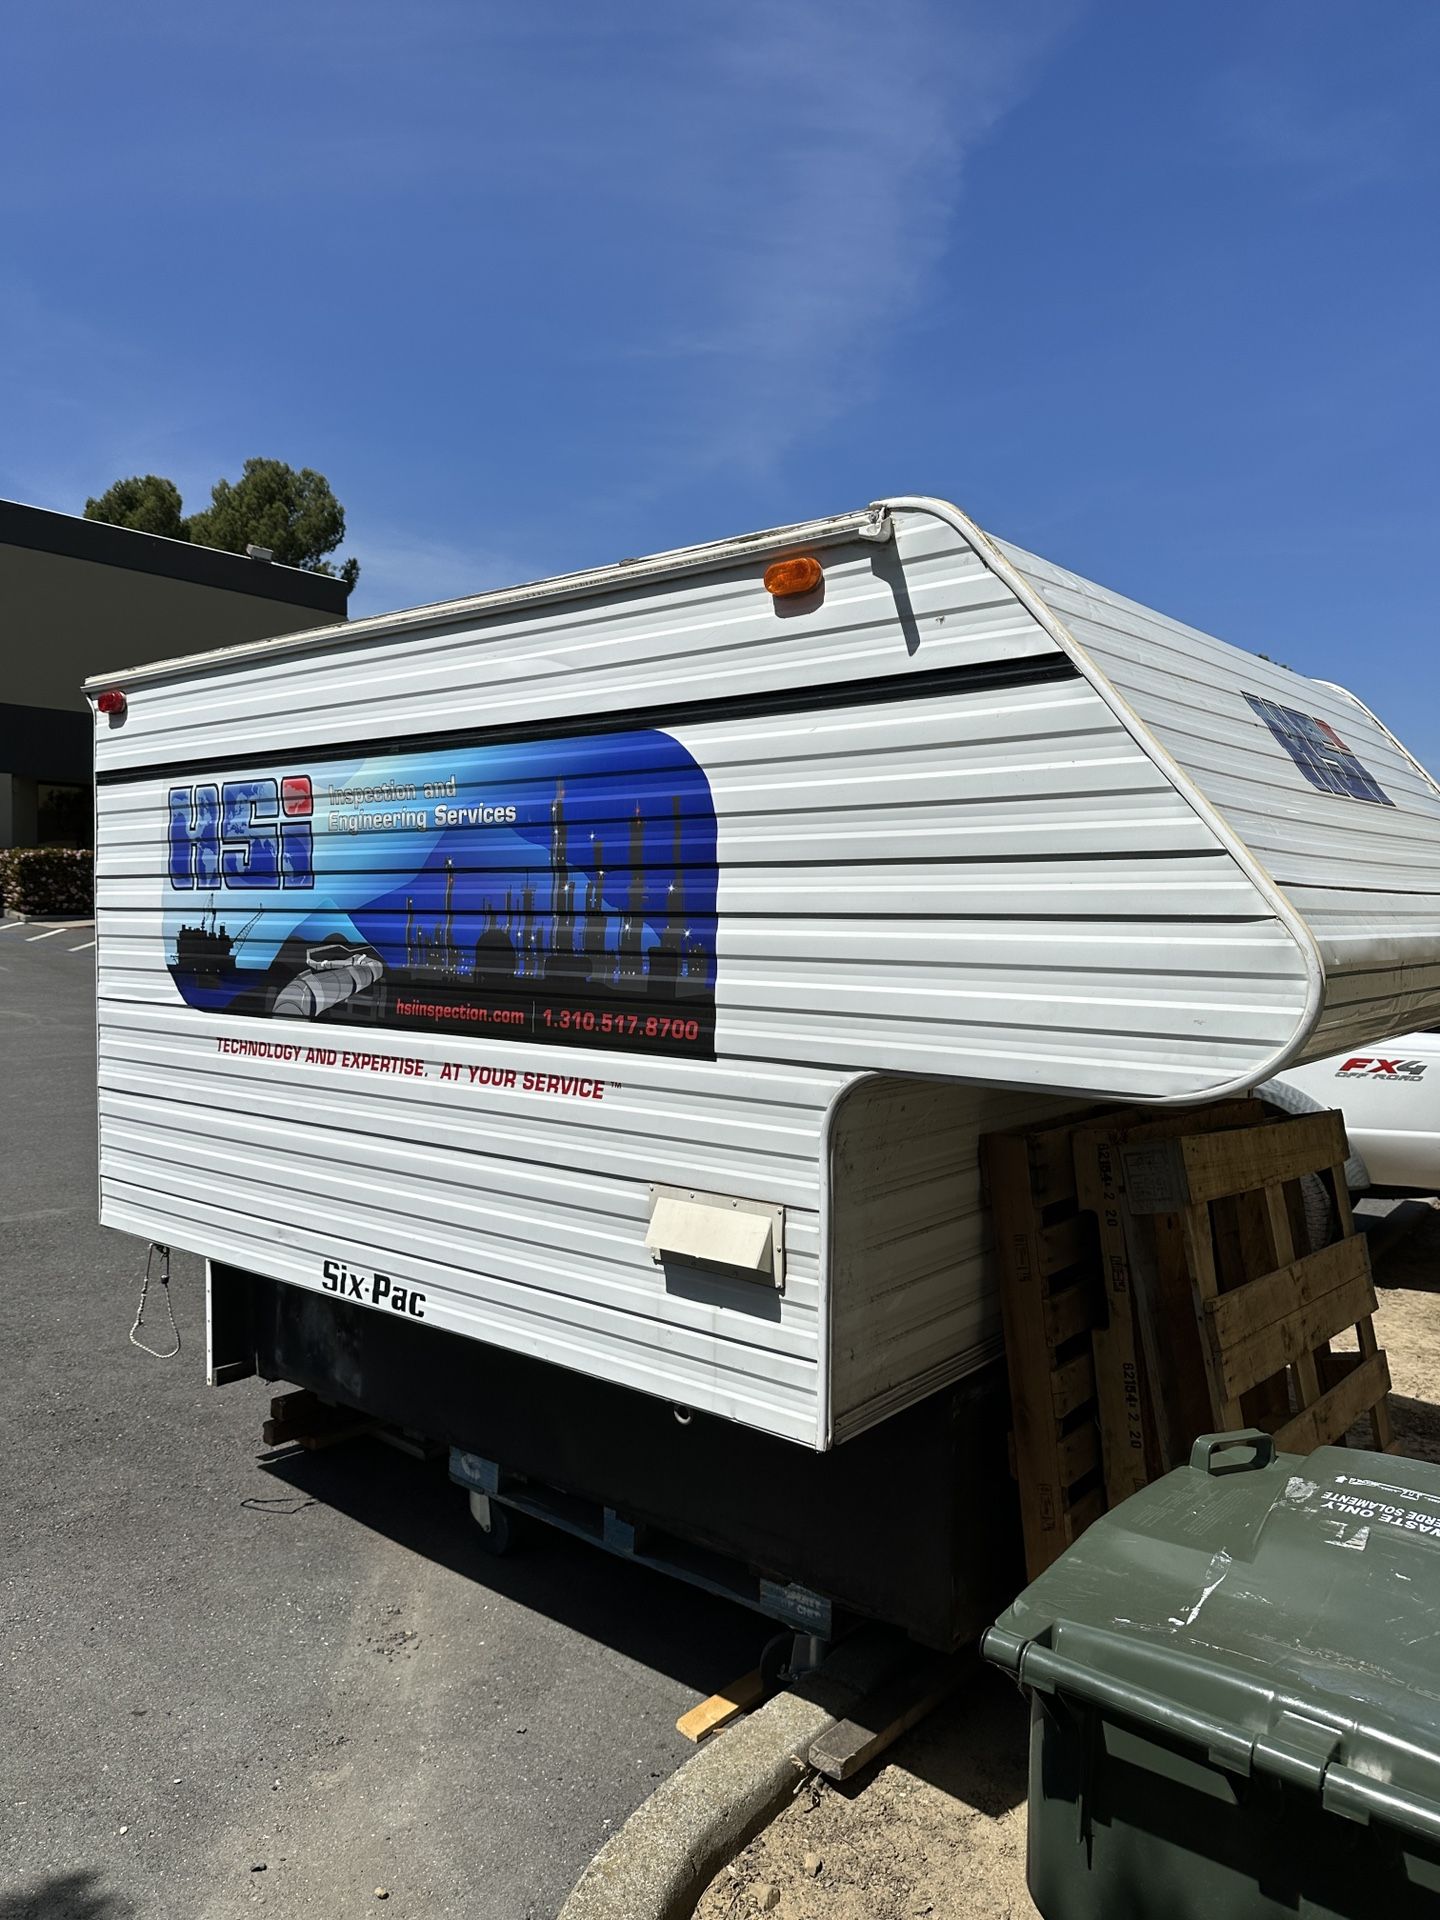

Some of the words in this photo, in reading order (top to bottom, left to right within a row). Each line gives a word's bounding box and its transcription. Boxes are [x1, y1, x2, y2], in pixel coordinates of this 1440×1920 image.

[328, 779, 417, 808] Inspection
[423, 774, 457, 798] and
[327, 806, 427, 835] Engineering
[434, 802, 516, 826] Services
[396, 998, 524, 1025] hsiinspection.com
[543, 1008, 699, 1040] 1.310.517.8700
[216, 1037, 302, 1061] TECHNOLOGY
[305, 1047, 337, 1066] AND
[341, 1051, 428, 1077] EXPERTISE.
[440, 1062, 463, 1081] AT
[468, 1064, 517, 1088] YOUR
[522, 1071, 605, 1099] SERVICE
[1334, 1071, 1369, 1079] OFF
[1372, 1073, 1424, 1082] ROAD
[1338, 1057, 1428, 1075] FX4
[1320, 1501, 1375, 1517] ONLY
[1321, 1491, 1405, 1516] SOLAMENTE
[1405, 1510, 1440, 1528] ERDE
